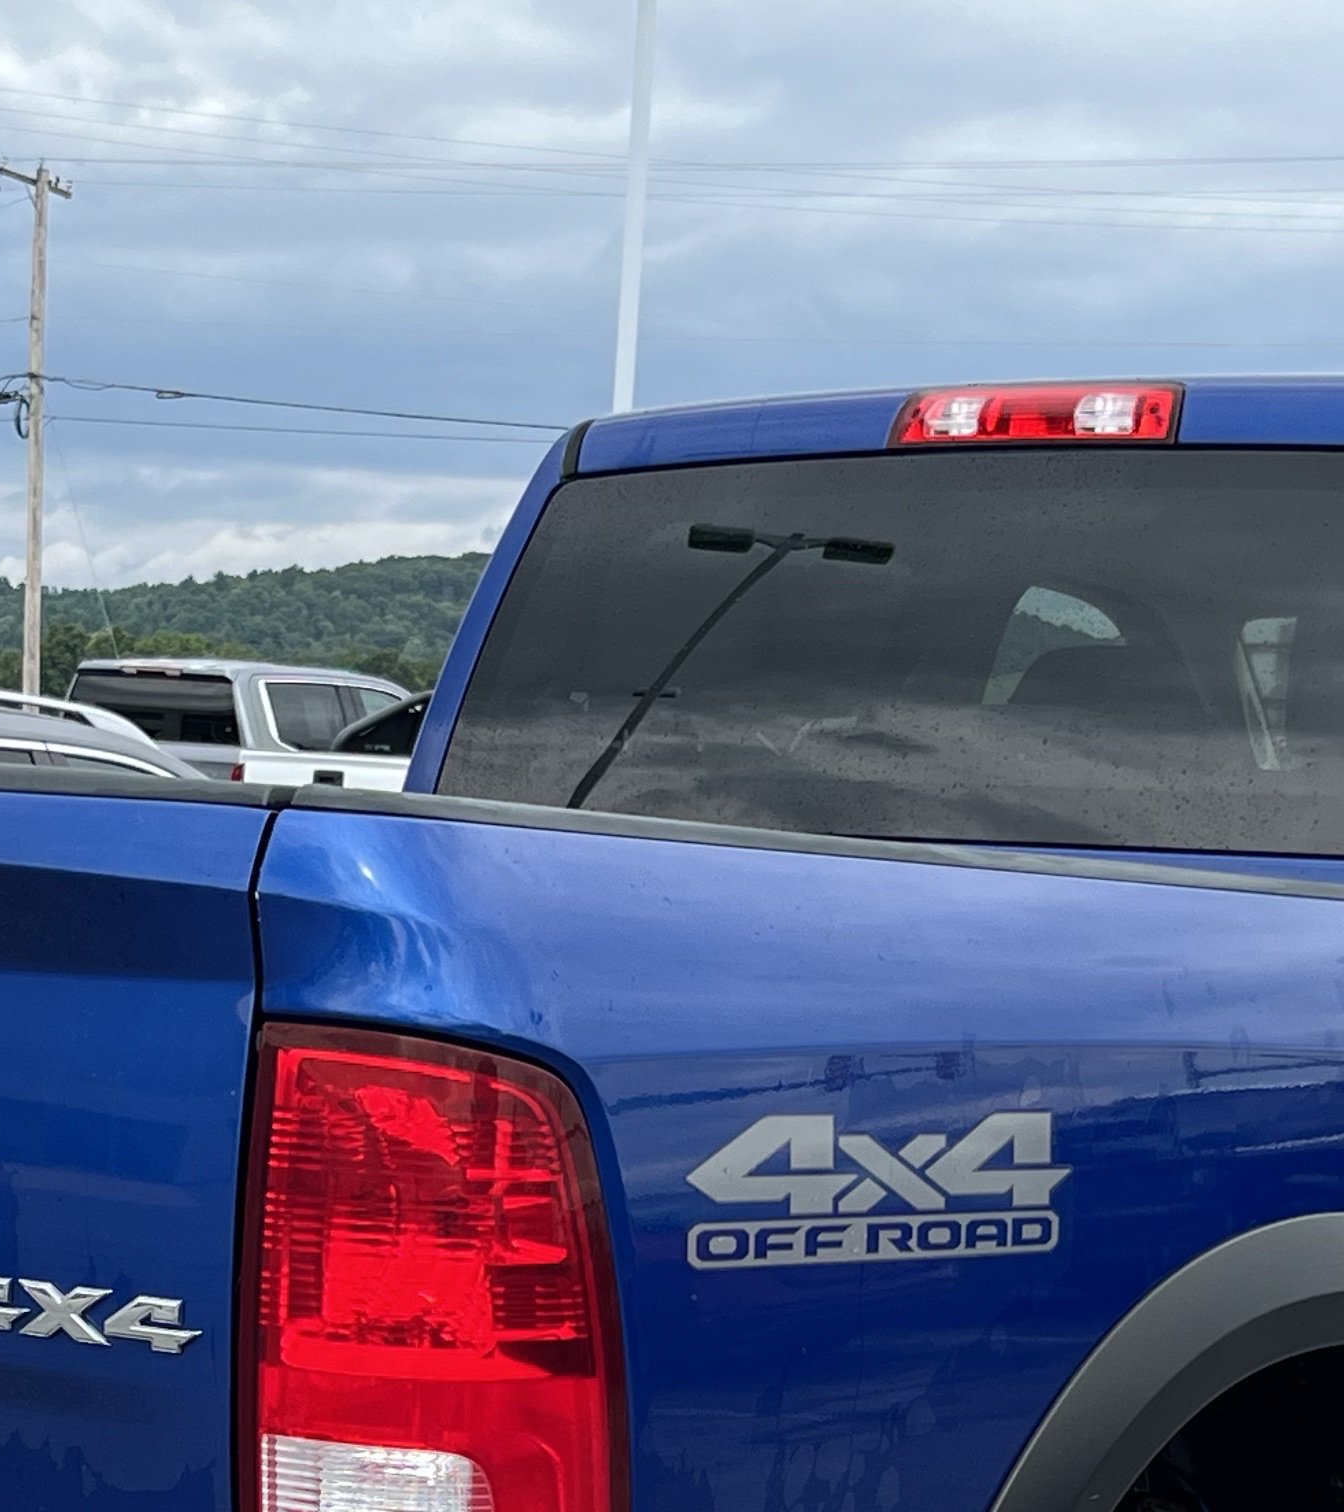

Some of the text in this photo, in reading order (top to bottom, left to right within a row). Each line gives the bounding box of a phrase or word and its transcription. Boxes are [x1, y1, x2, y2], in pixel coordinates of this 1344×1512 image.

[686, 1111, 1074, 1215] 4x4
[695, 1217, 1052, 1262] OFF ROAD
